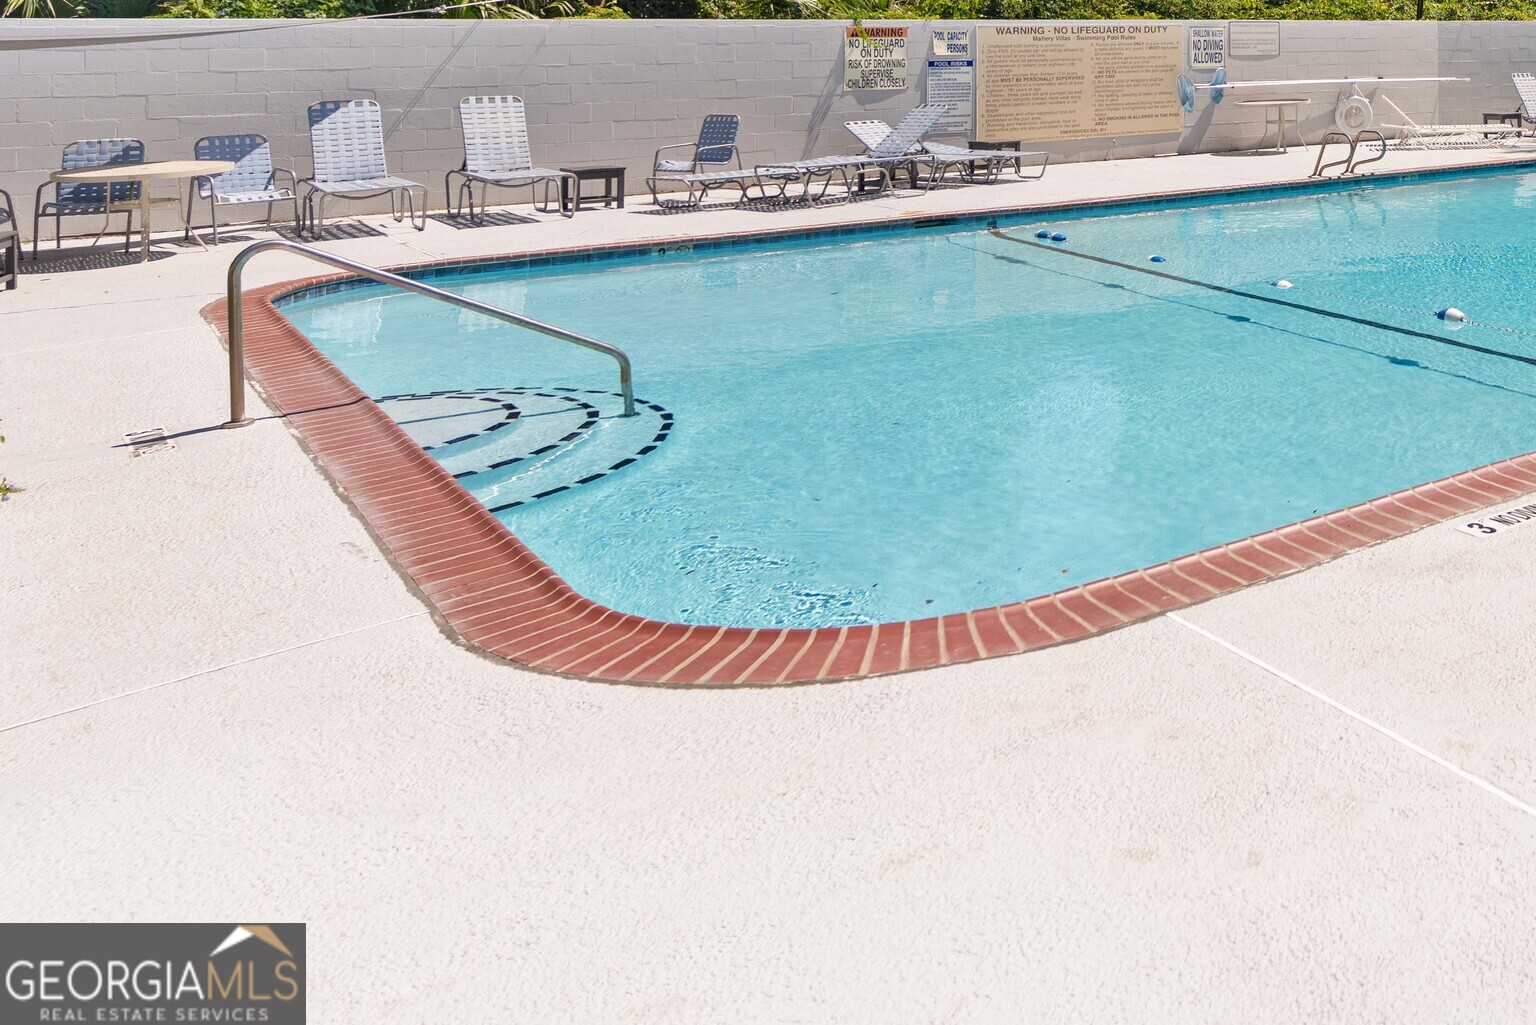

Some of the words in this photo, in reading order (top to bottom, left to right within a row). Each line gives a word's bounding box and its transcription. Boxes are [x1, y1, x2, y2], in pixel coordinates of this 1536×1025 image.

[996, 27, 1045, 35] WARNING
[1053, 27, 1068, 35] NO
[1071, 26, 1125, 34] LIFEGUARD
[1128, 26, 1141, 34] ON
[1144, 26, 1168, 34] DUTY
[934, 32, 945, 41] POOL
[947, 32, 967, 40] CAPACITY
[849, 39, 860, 48] NO
[863, 39, 905, 48] LIFEGUARD
[1193, 40, 1201, 50] NO
[1203, 40, 1223, 50] DIVING
[861, 49, 871, 58] ON
[874, 48, 893, 57] DUTY
[947, 44, 968, 53] PERSONS
[1193, 52, 1222, 63] ALLOWED
[849, 59, 863, 68] RISK
[864, 59, 872, 68] OF
[874, 59, 906, 68] DROWNING
[861, 69, 893, 78] SUPERVISE
[848, 78, 878, 88] CHILDREN
[879, 78, 906, 87] CLOSELY
[1467, 523, 1497, 534] 3
[1489, 515, 1521, 526] NO
